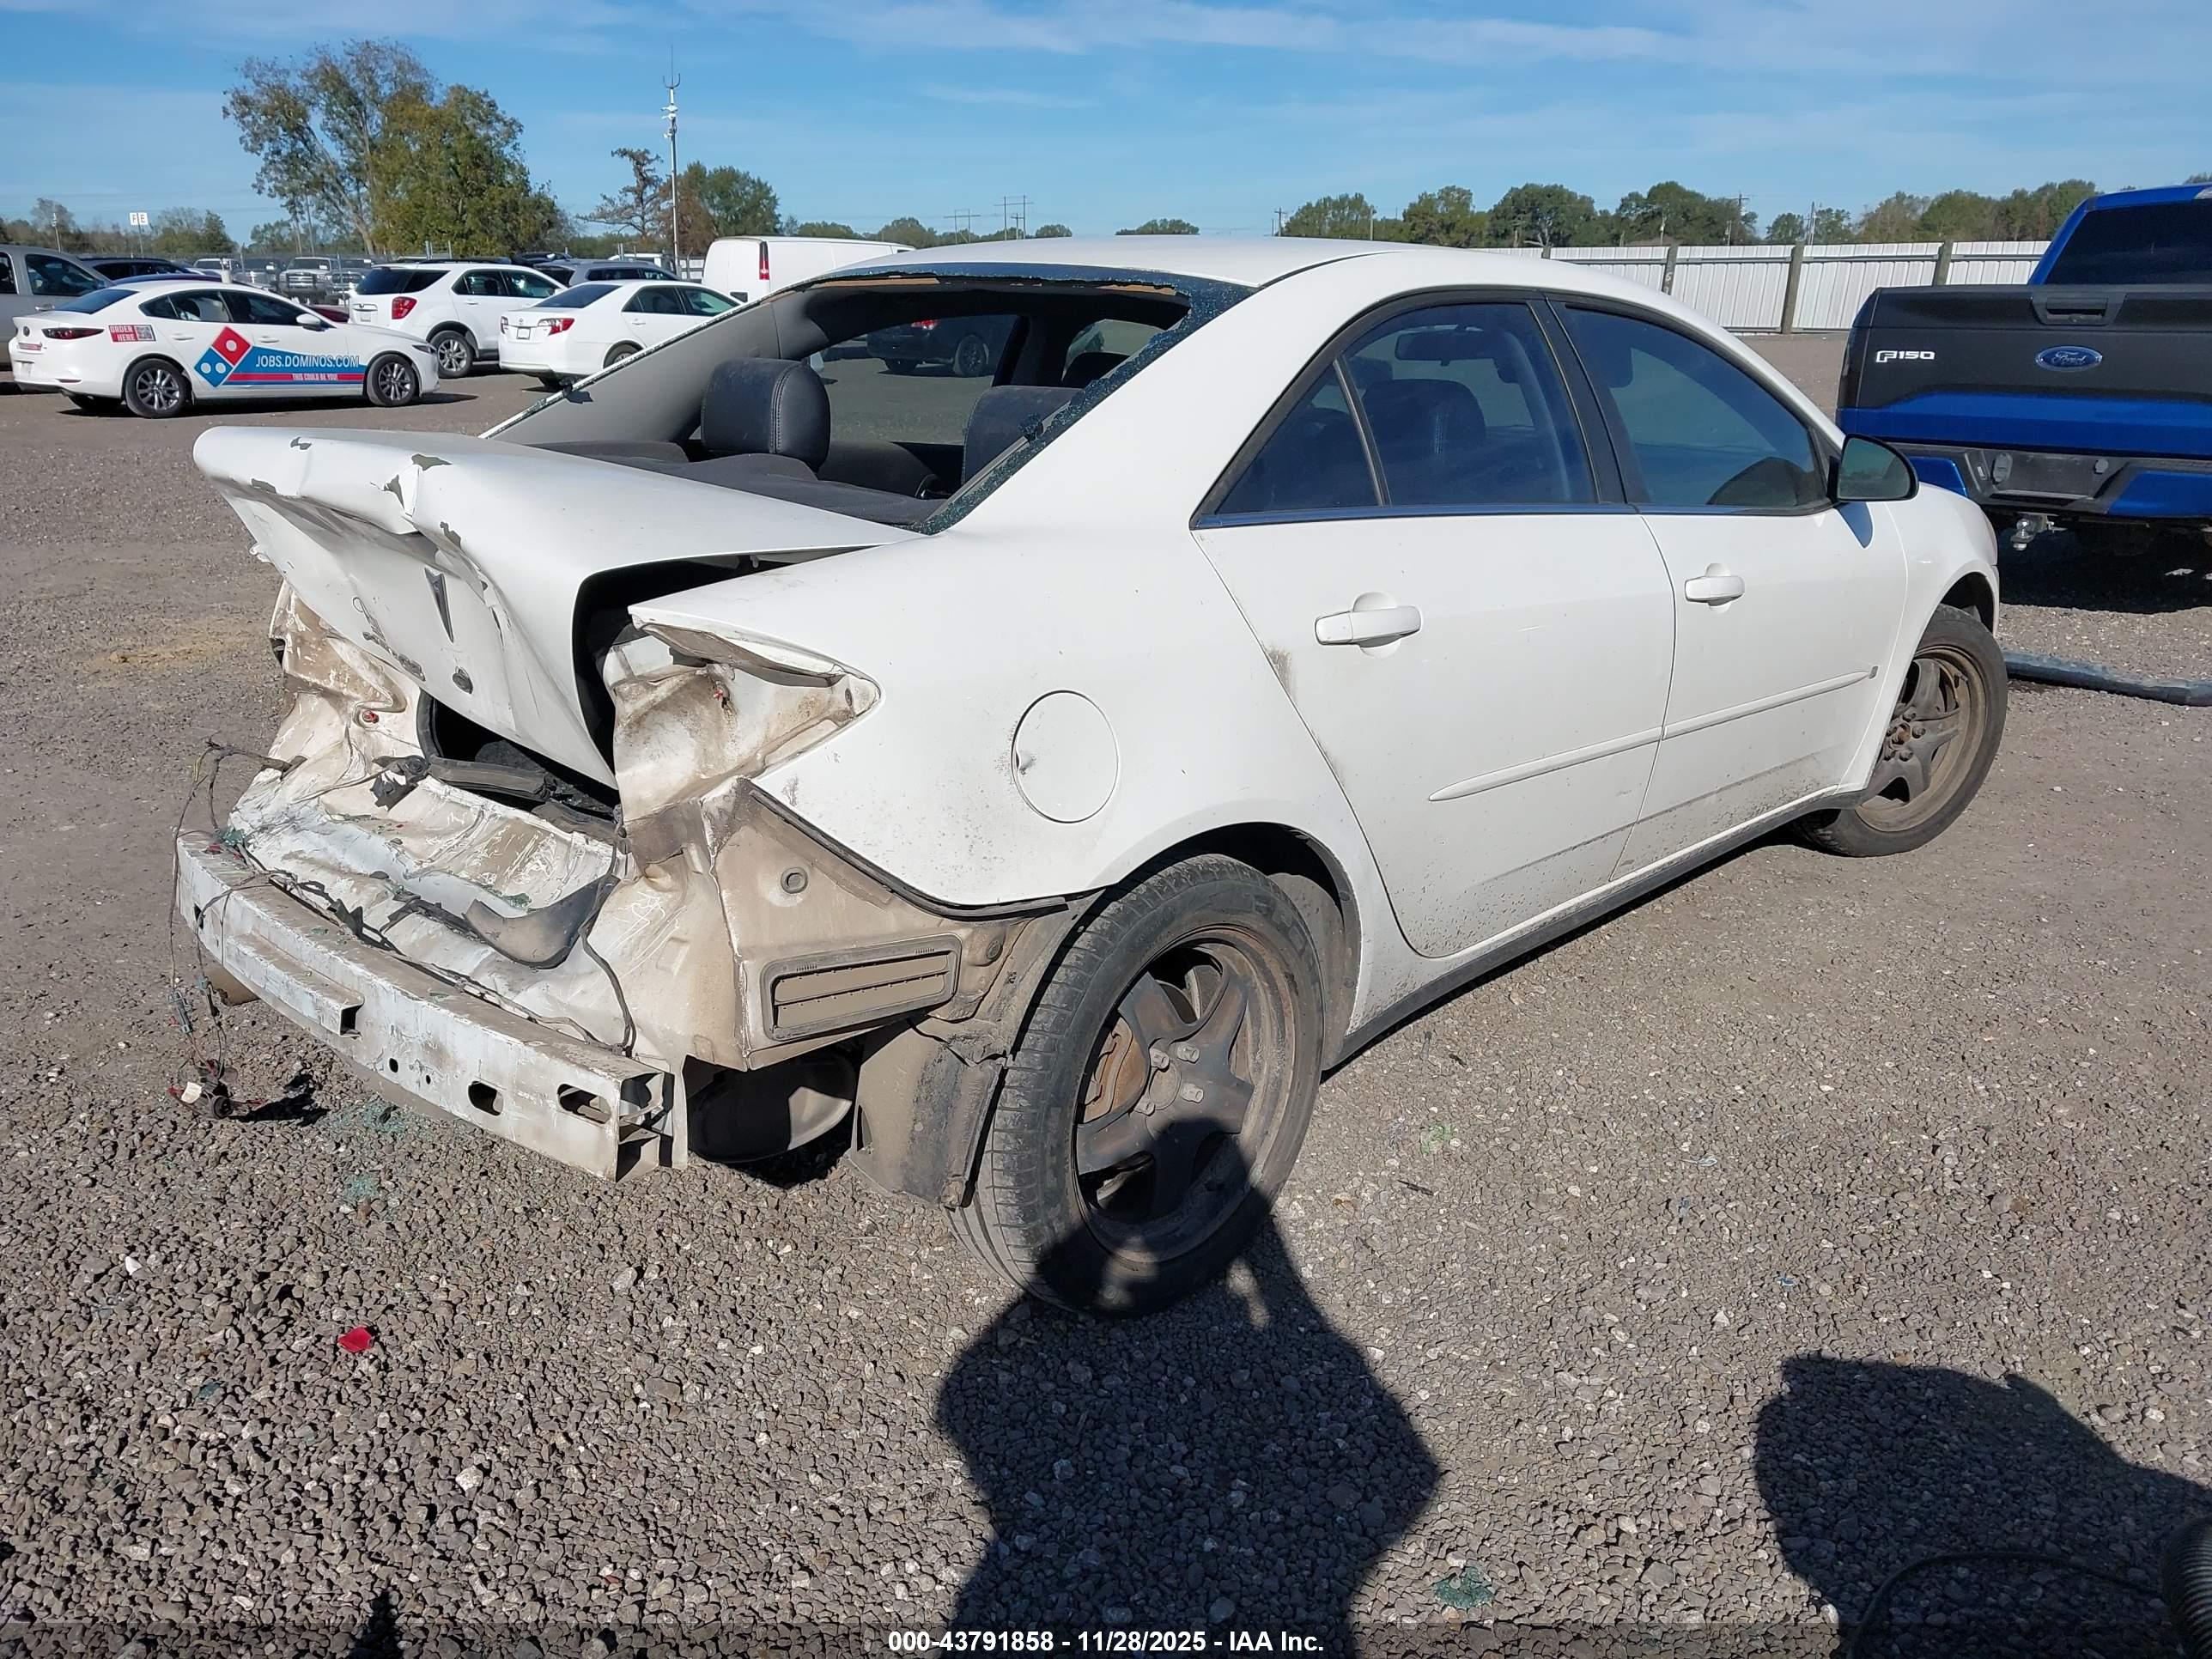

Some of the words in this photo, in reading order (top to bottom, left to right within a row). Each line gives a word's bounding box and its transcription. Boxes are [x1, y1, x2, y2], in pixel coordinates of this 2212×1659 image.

[112, 325, 134, 333] ORDER
[255, 355, 359, 368] JOBS.DOMINOS.COM
[2051, 350, 2087, 366] Ford
